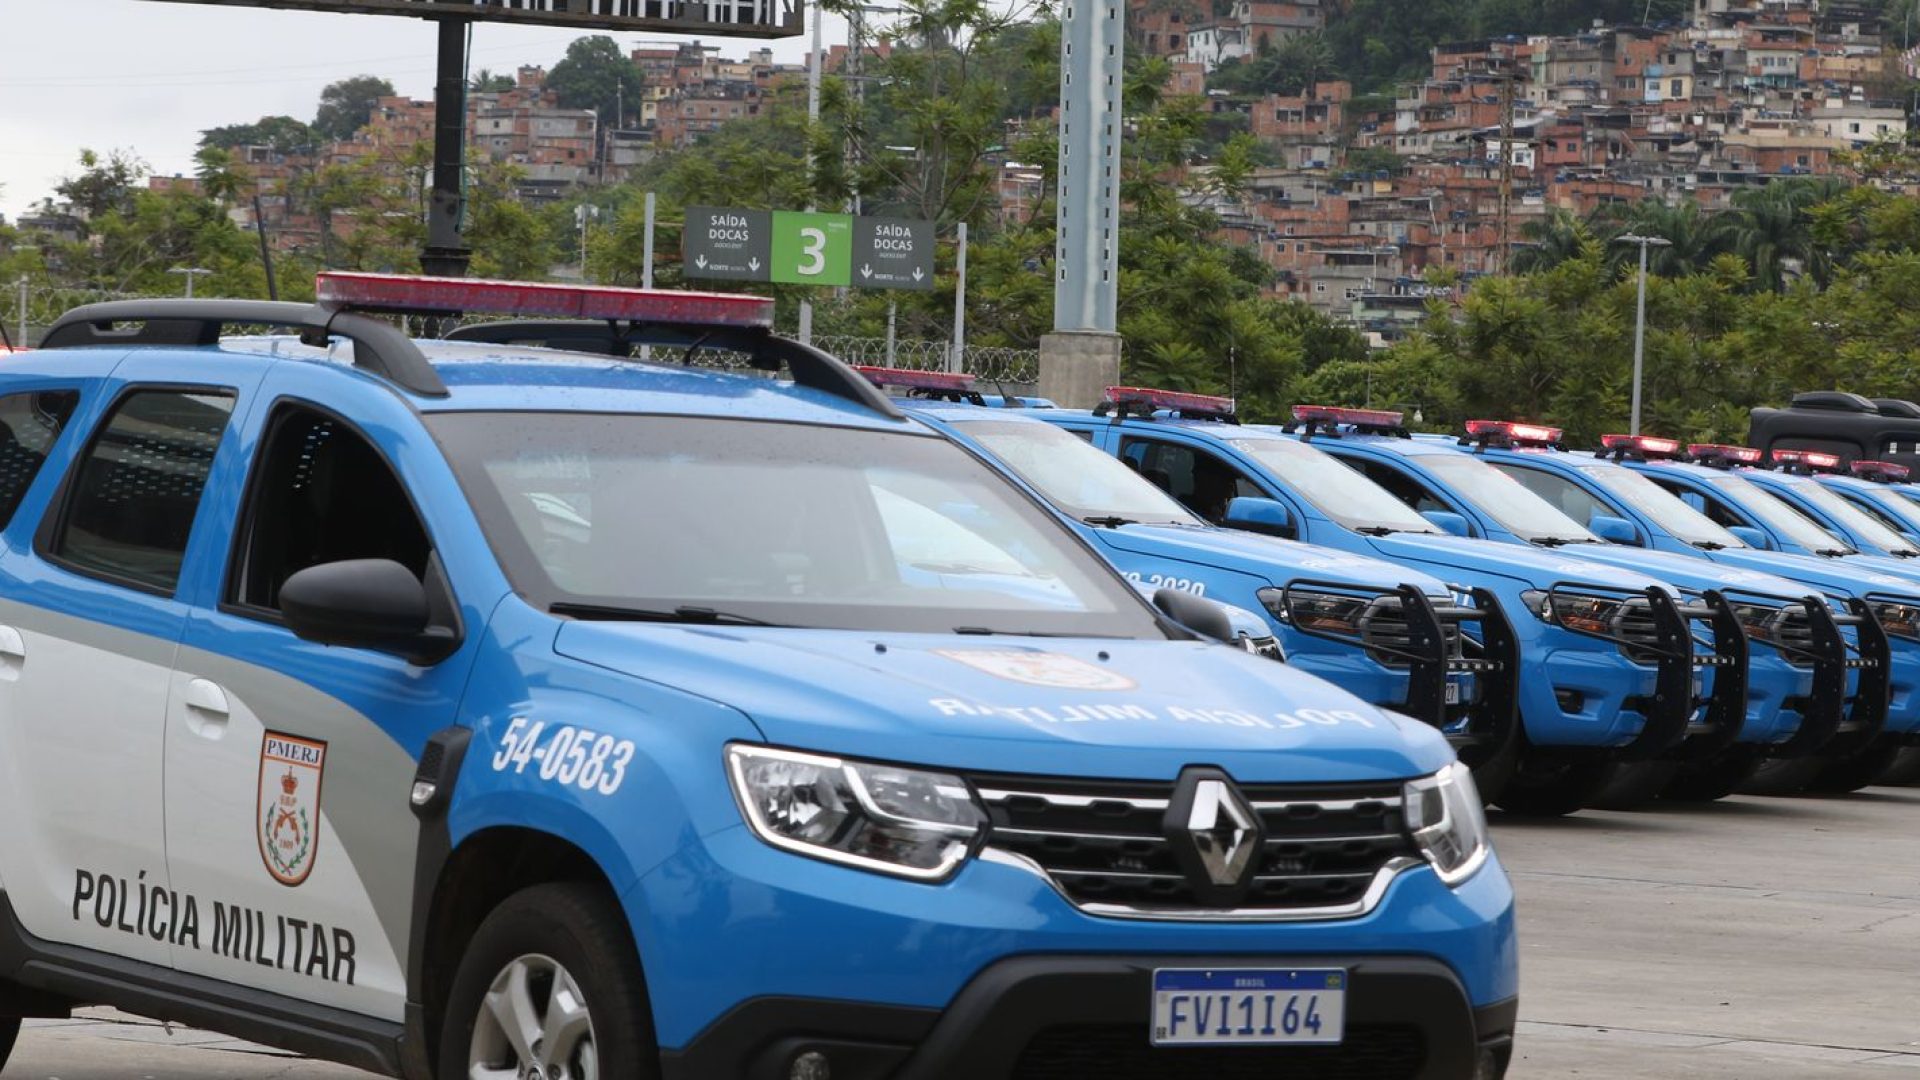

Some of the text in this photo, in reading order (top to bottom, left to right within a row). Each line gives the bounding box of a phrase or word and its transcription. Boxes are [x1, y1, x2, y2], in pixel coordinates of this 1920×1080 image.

[711, 213, 748, 228] SAÍDA
[875, 223, 912, 238] SAÍDA
[709, 228, 749, 241] DOCAS
[874, 238, 913, 251] DOCAS
[797, 227, 826, 275] 3
[266, 739, 321, 765] PMERJ
[492, 717, 636, 796] 54-0583
[72, 868, 357, 986] POLÍCIA MILITAR
[1169, 994, 1323, 1037] FVI1I64
